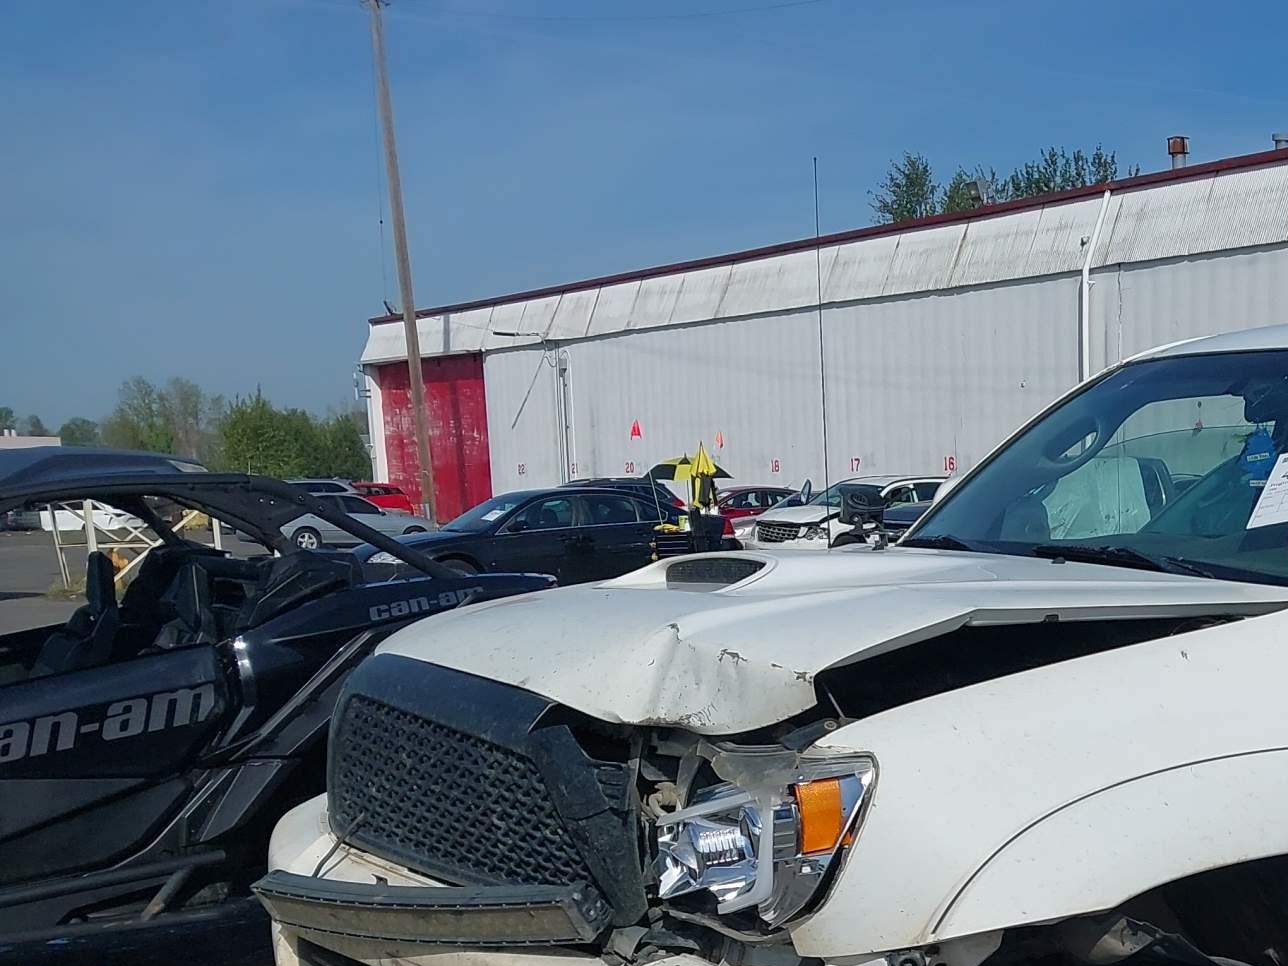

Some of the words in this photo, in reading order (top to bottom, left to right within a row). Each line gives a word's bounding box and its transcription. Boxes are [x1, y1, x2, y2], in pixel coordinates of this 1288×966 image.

[625, 462, 635, 474] 20
[771, 459, 780, 473] 18
[850, 458, 860, 472] 17
[944, 456, 955, 471] 16
